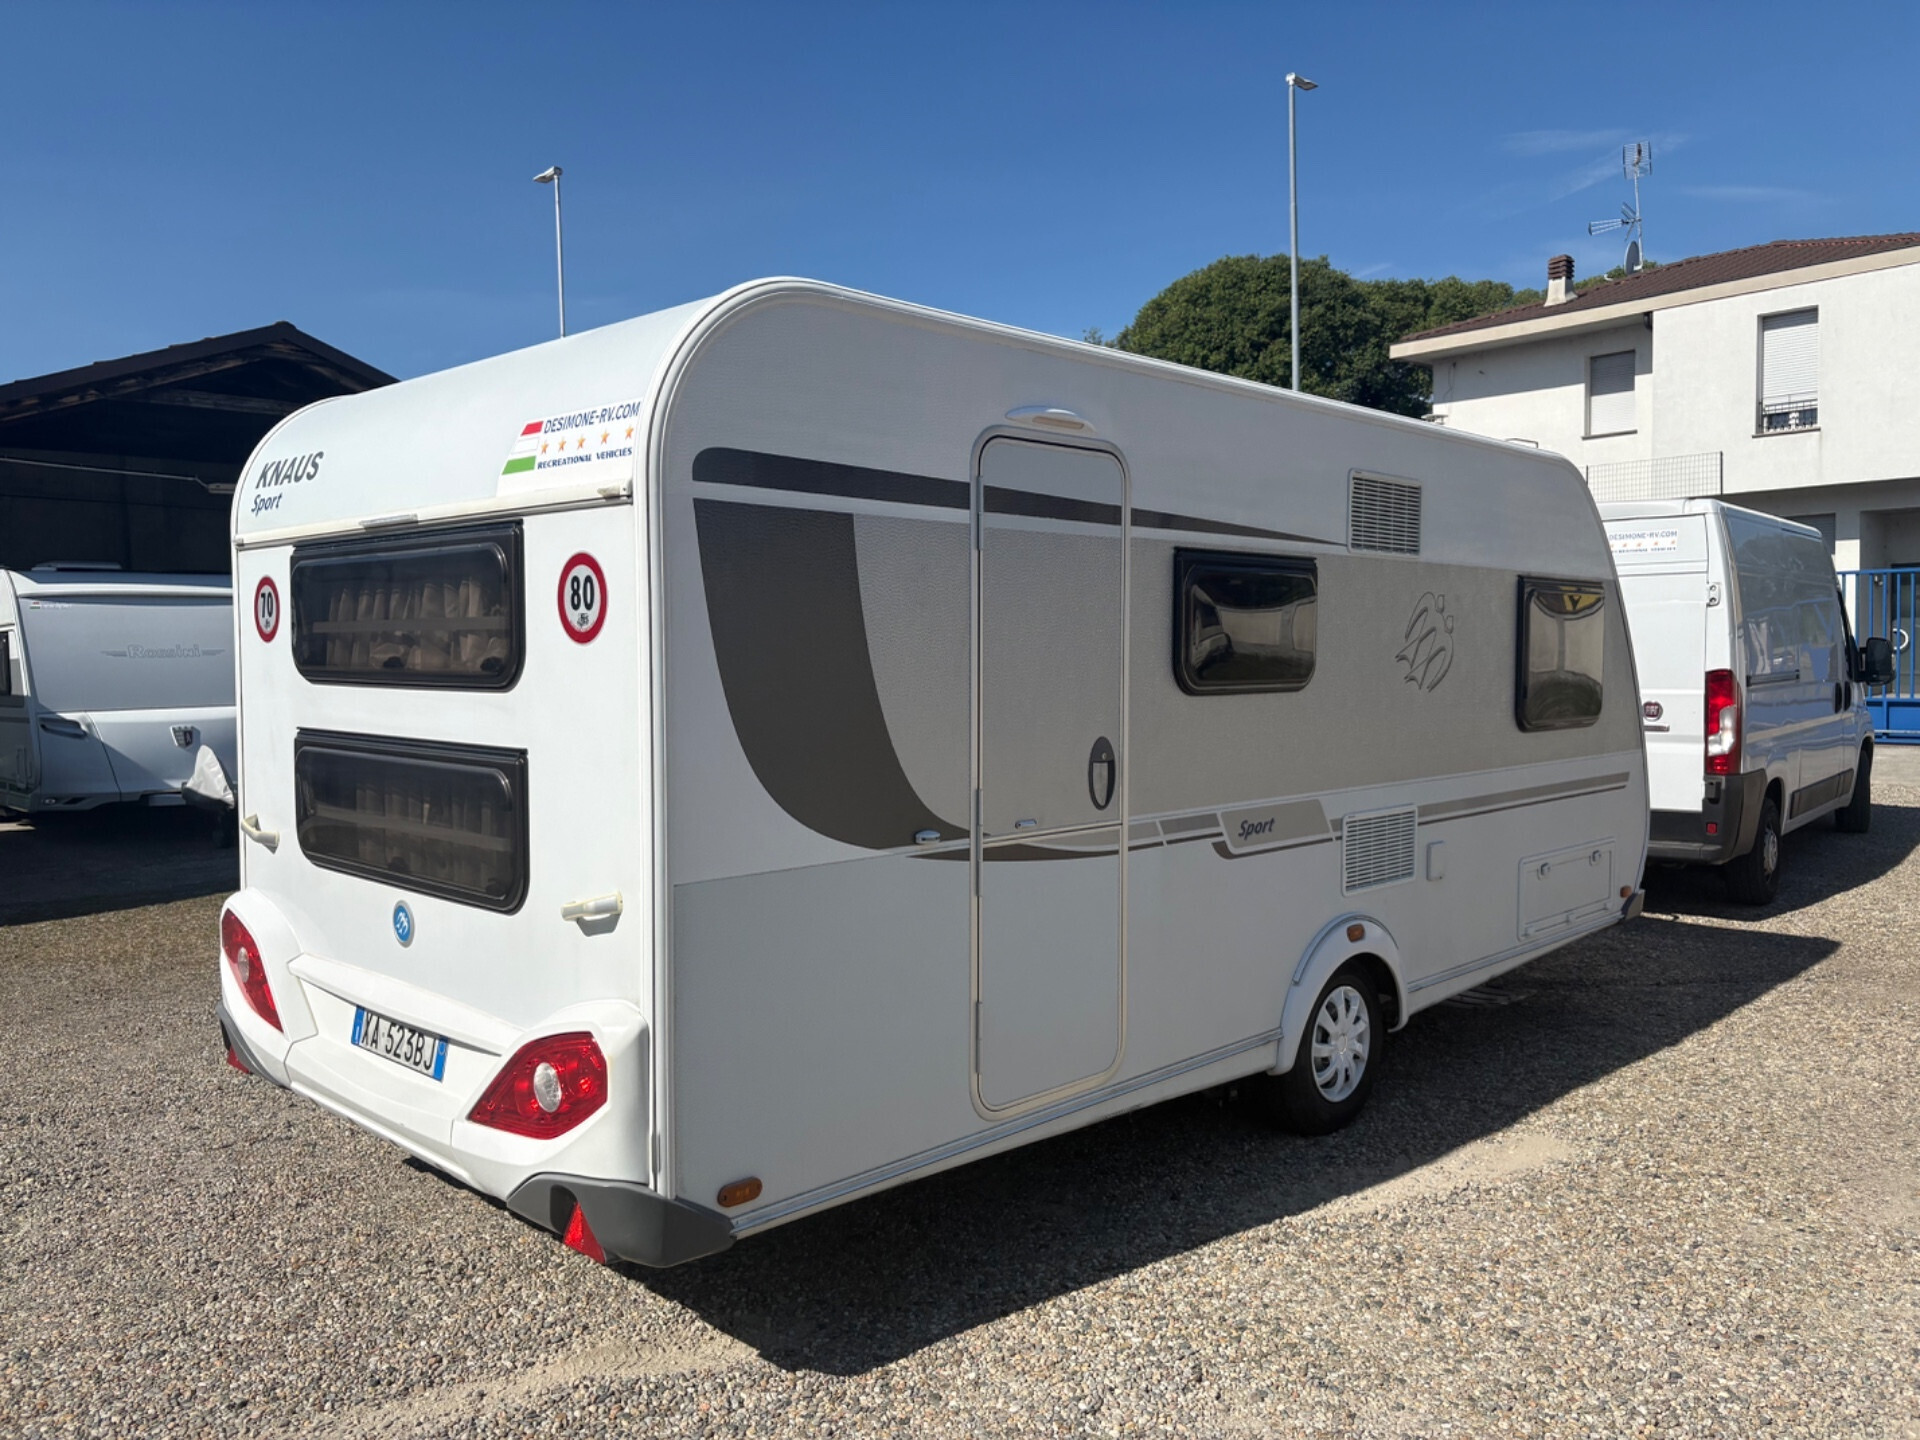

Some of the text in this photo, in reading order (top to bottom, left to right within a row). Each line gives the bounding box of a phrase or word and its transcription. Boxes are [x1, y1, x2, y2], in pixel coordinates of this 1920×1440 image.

[543, 401, 641, 434] DESIMONE-RV.COM
[255, 451, 324, 490] KNAUS
[537, 447, 633, 470] RECREATIONAL VEHICLES
[251, 492, 283, 518] Sport
[260, 591, 274, 618] 70
[570, 574, 595, 611] 80
[1238, 817, 1275, 841] Sport
